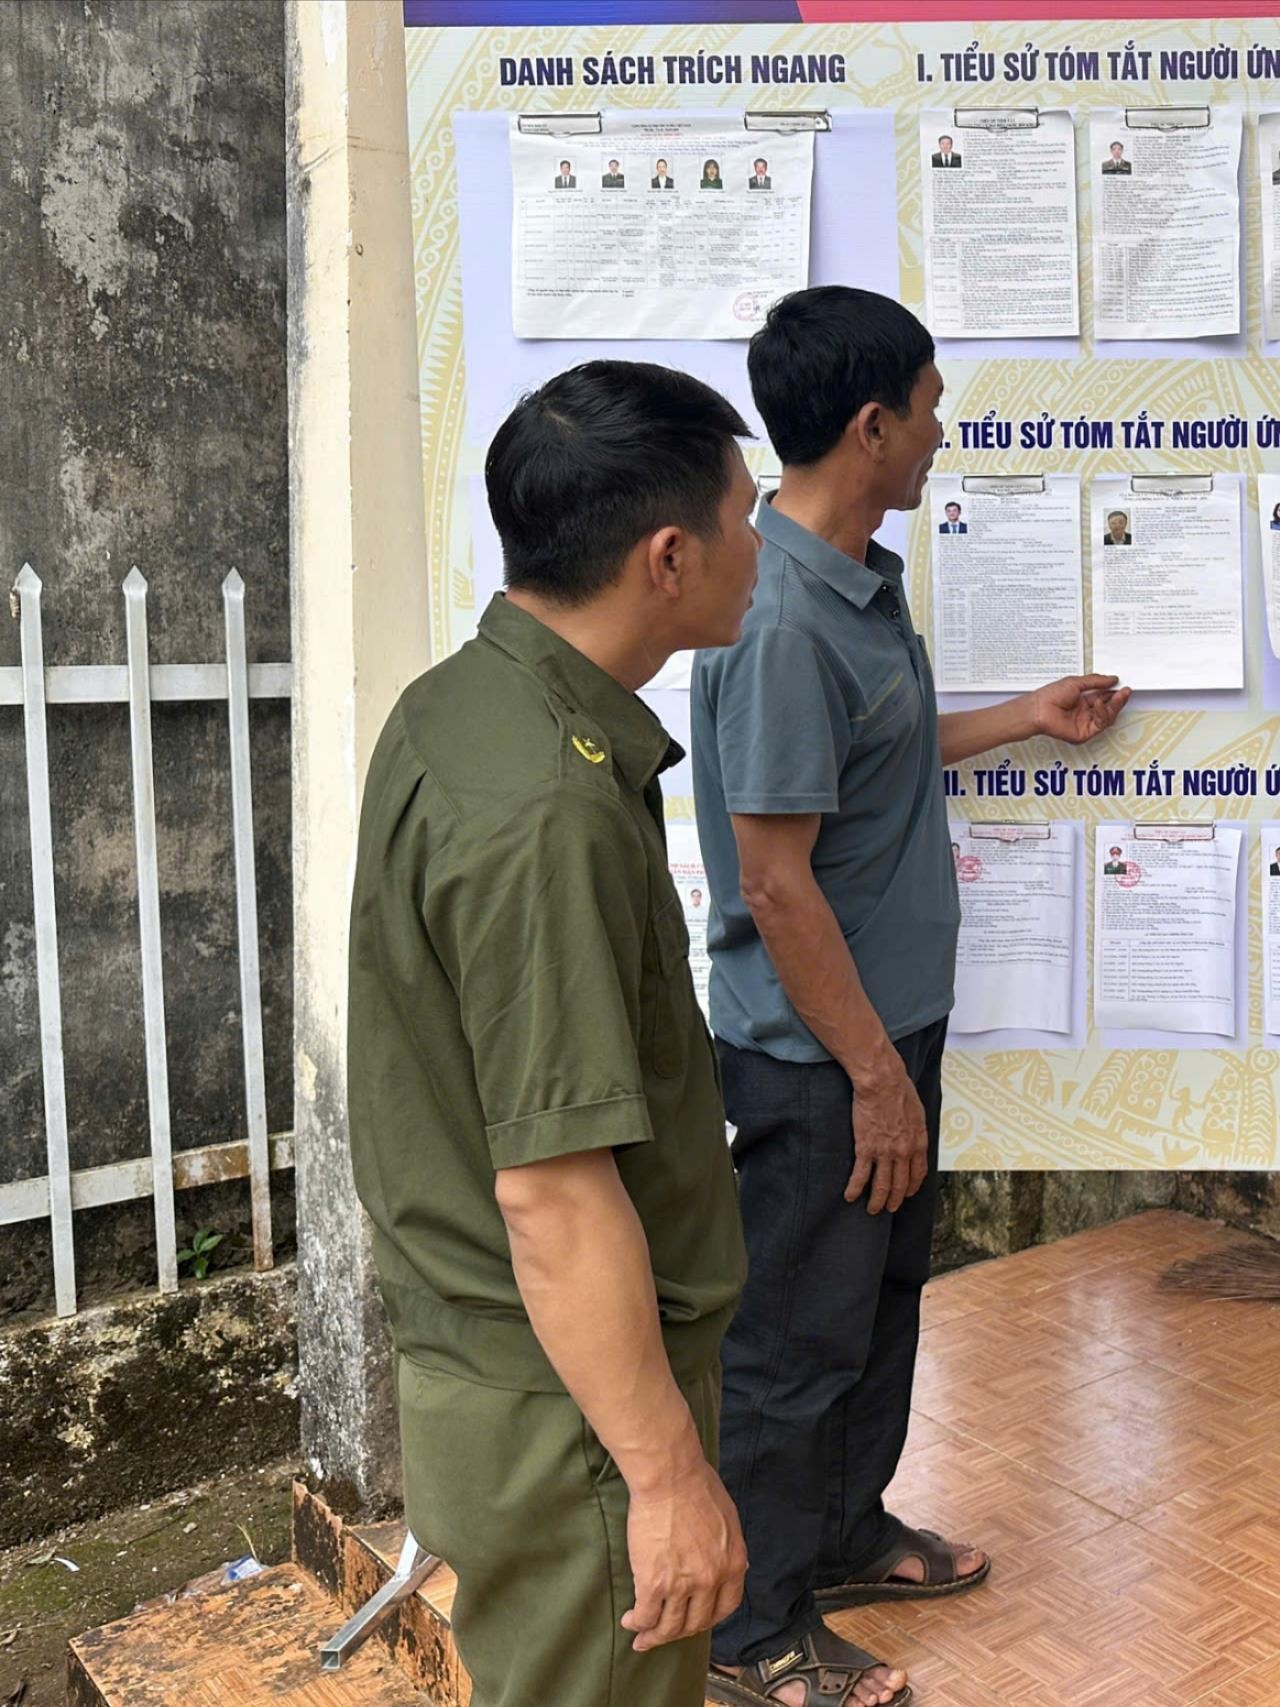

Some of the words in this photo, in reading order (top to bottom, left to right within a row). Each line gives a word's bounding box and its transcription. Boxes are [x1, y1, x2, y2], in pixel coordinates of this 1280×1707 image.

[499, 57, 574, 86] DANH
[582, 50, 655, 86] SÁCH
[662, 49, 742, 84] TRÍCH
[751, 54, 846, 84] NGANG
[917, 53, 933, 82] I.
[940, 40, 995, 82] TIỂU
[1003, 42, 1040, 82] SỬ
[1044, 45, 1099, 81] TÓM
[1107, 40, 1152, 81] TẮT
[1160, 43, 1238, 81] NGƯỜI
[958, 410, 1012, 450] TIỂU
[1020, 411, 1056, 449] SỬ
[1060, 415, 1113, 449] TÓM
[1120, 410, 1165, 449] TẮT
[1172, 413, 1248, 449] NGƯỜI
[973, 759, 1026, 797] TIỂU
[1034, 761, 1068, 797] SỬ
[1073, 764, 1125, 797] TÓM
[1132, 759, 1176, 796] TẮT
[1183, 763, 1257, 797] NGƯỜI
